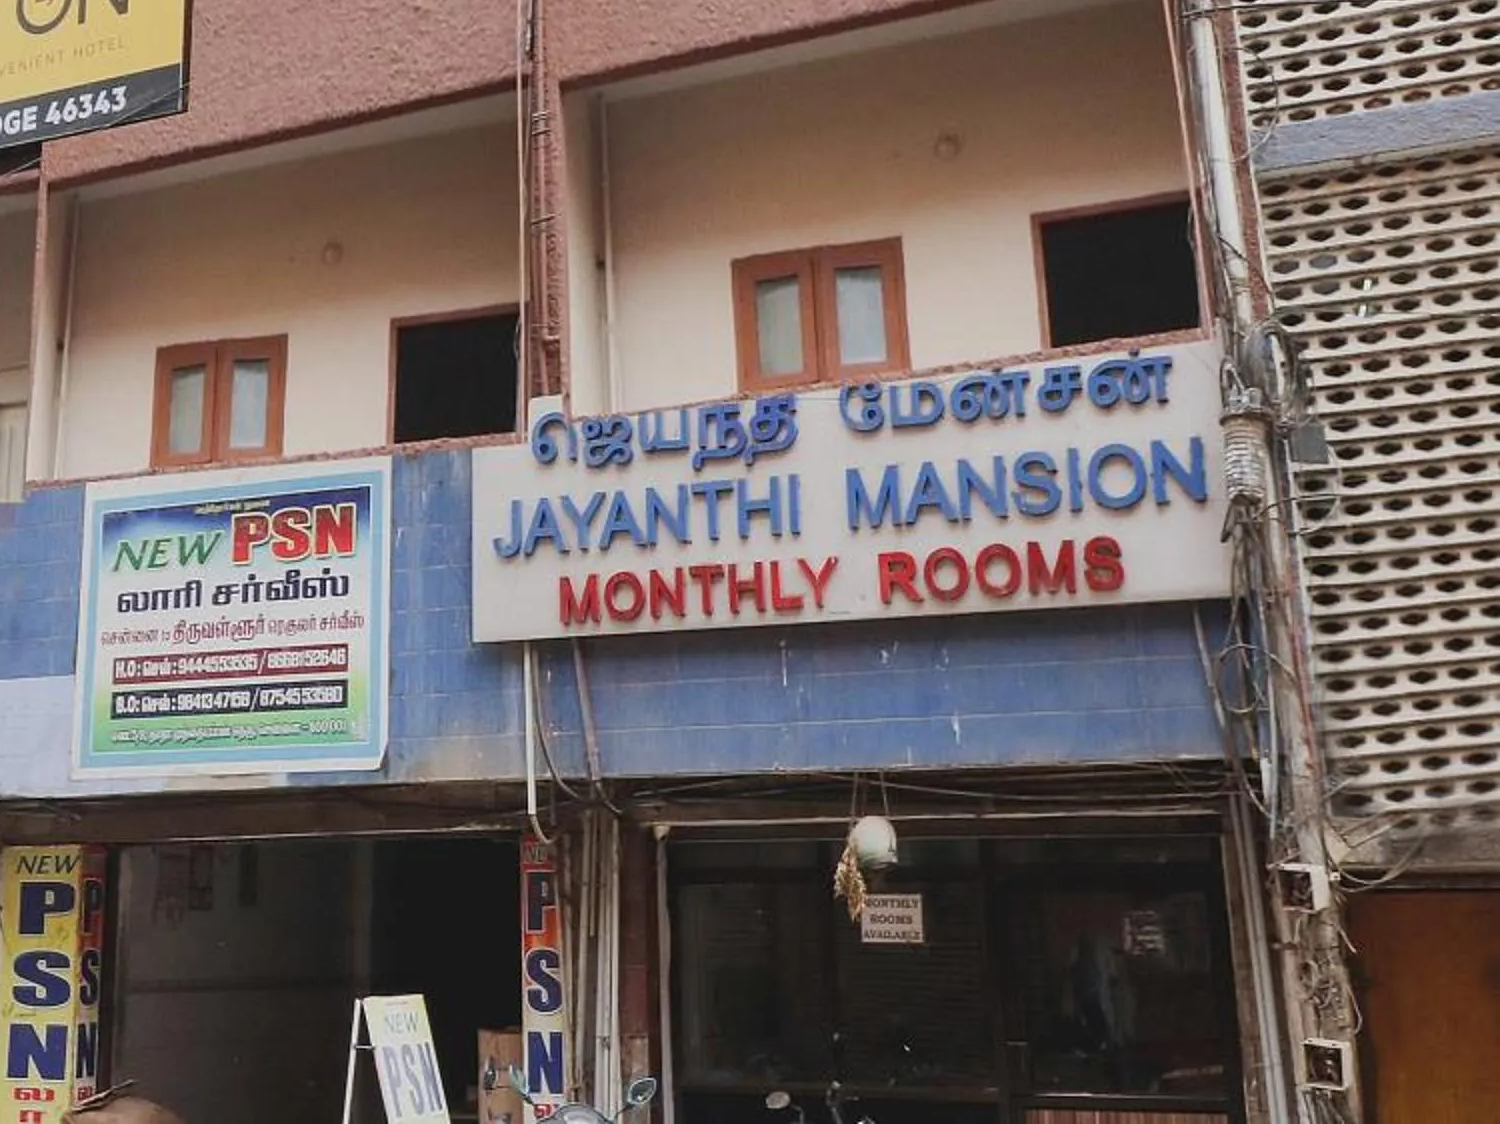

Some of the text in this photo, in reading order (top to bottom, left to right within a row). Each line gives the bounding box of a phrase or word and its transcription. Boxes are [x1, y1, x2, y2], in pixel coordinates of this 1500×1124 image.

[73, 37, 126, 60] HOTEL
[43, 85, 129, 125] 46343
[838, 348, 1174, 433] மேன்சன்
[492, 434, 1208, 560] JAYANTHI MANSION
[112, 502, 358, 572] NEW PSN
[116, 567, 350, 613] லாரி சர்வீஸ்
[558, 534, 1126, 626] MONTHLY ROOMS
[17, 854, 81, 875] NEW
[870, 914, 913, 924] ROOMS
[7, 881, 75, 1081] PSN
[384, 1010, 419, 1033] NEW
[381, 1041, 443, 1117] PSN
